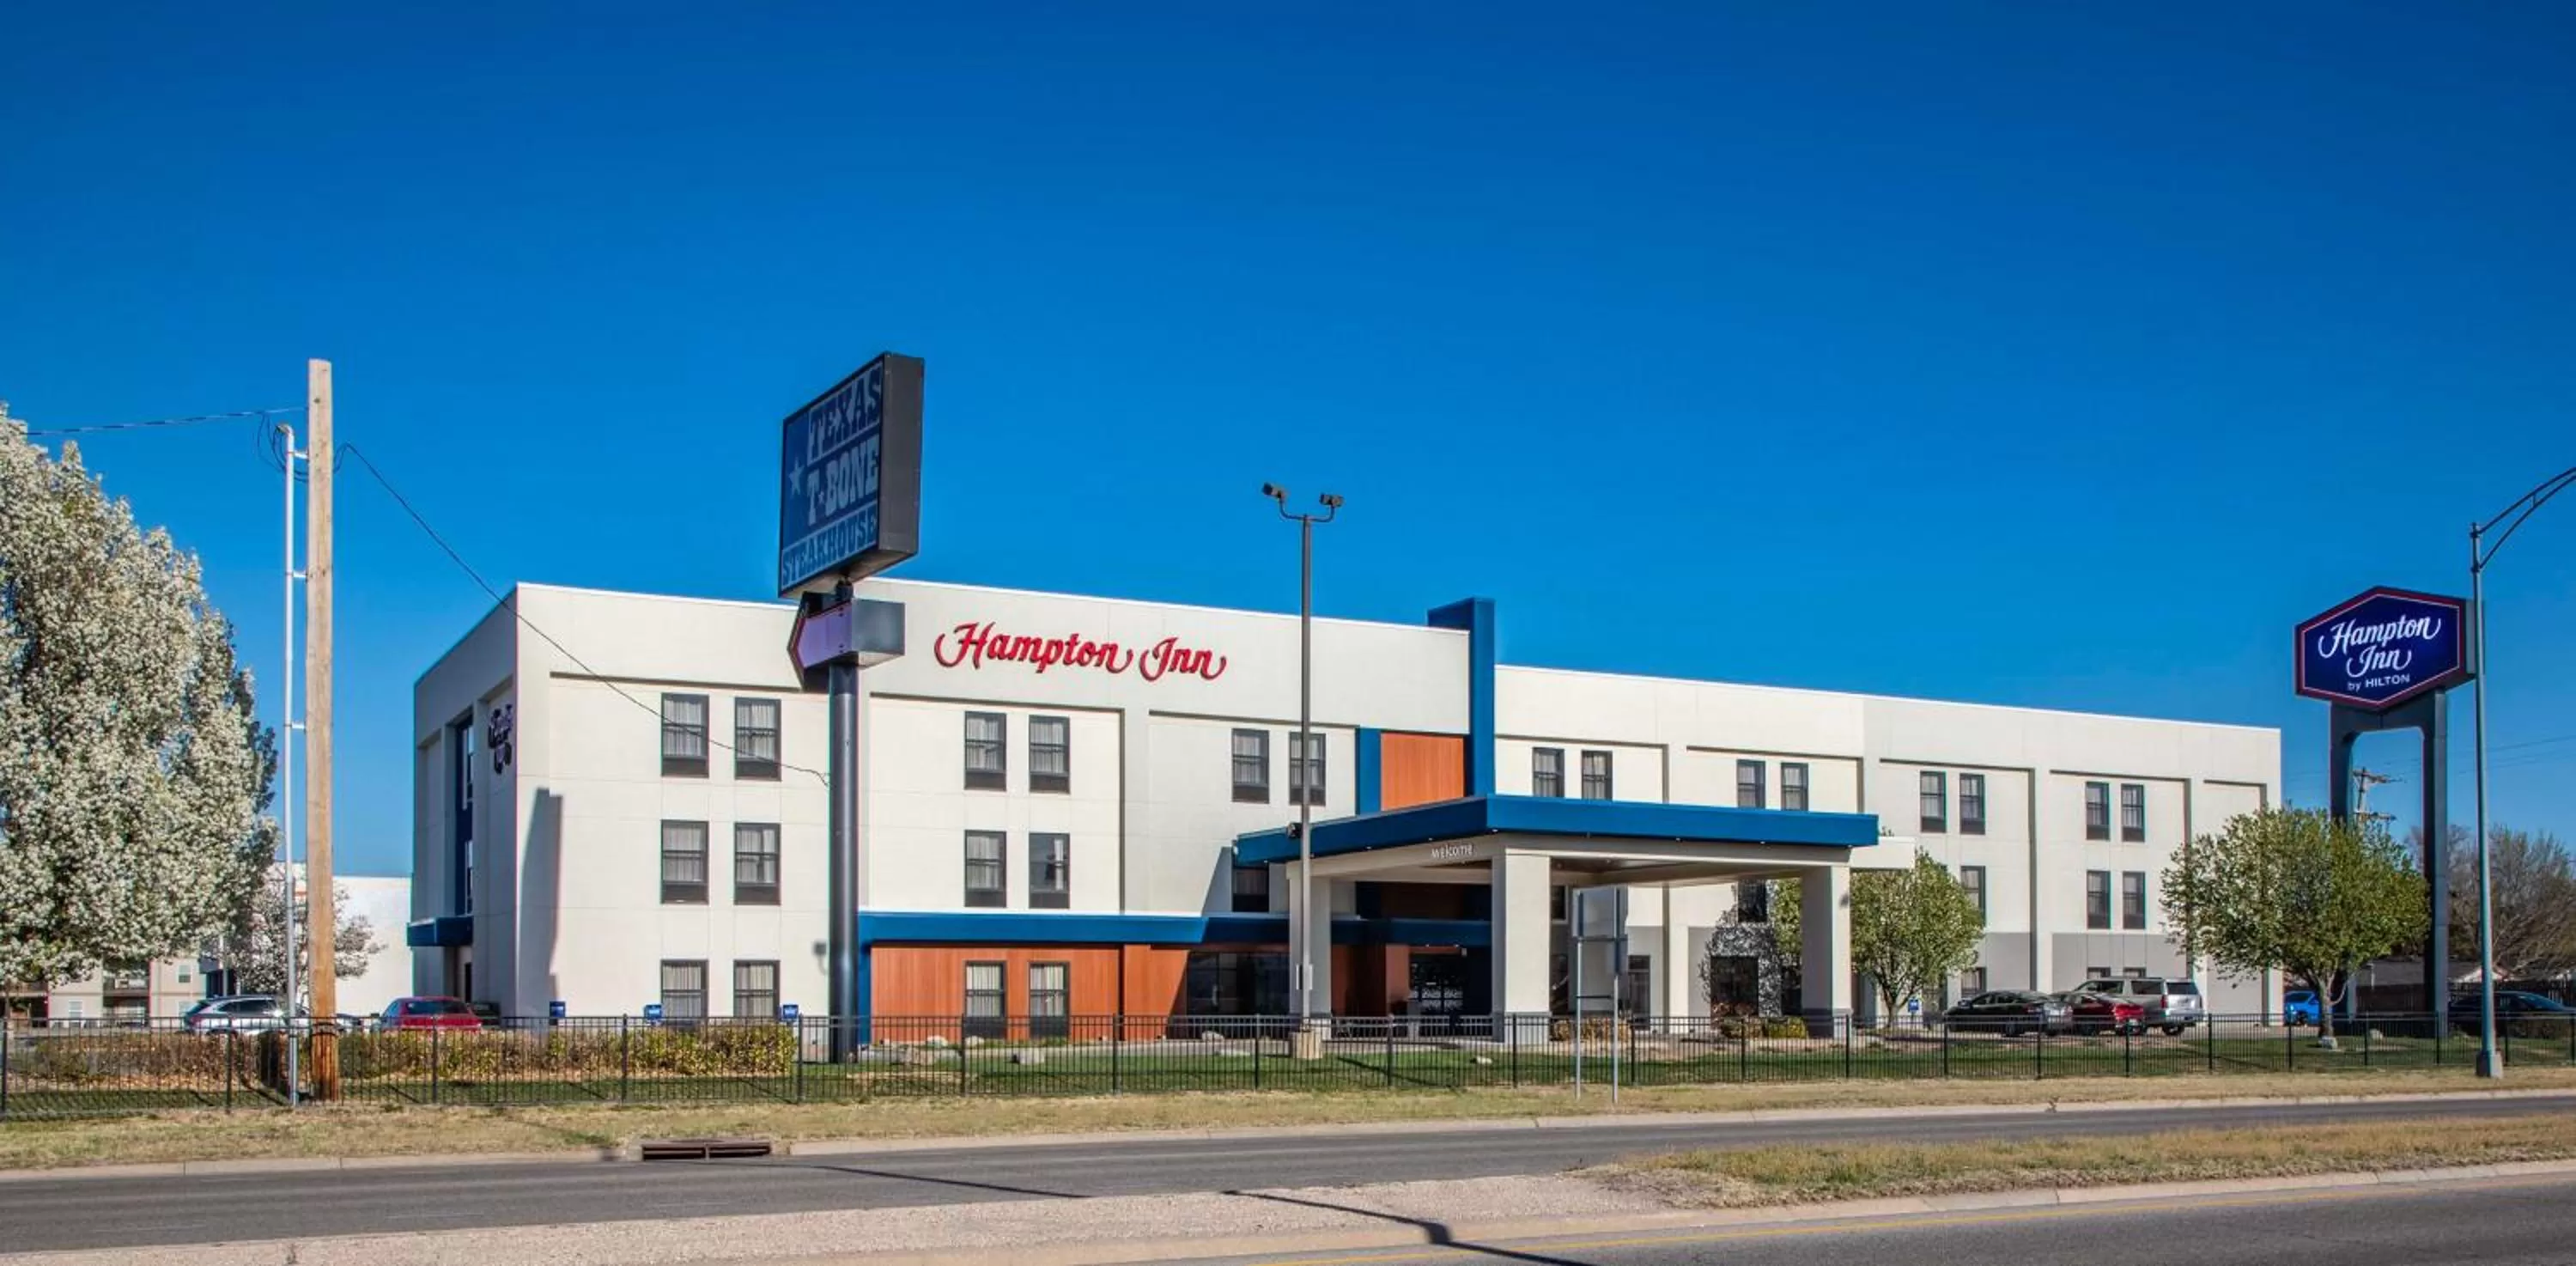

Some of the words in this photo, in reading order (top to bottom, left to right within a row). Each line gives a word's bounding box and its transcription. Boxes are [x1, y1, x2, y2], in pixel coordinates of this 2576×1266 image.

[810, 367, 880, 460] TEXAS
[782, 508, 878, 586] STEAKHOUSE
[934, 622, 1133, 673] Hampton
[1139, 637, 1226, 681] Inn
[2318, 614, 2441, 658] Hampton
[2346, 646, 2411, 678] Inn
[2348, 682, 2361, 692] by
[2366, 673, 2410, 688] HILTON
